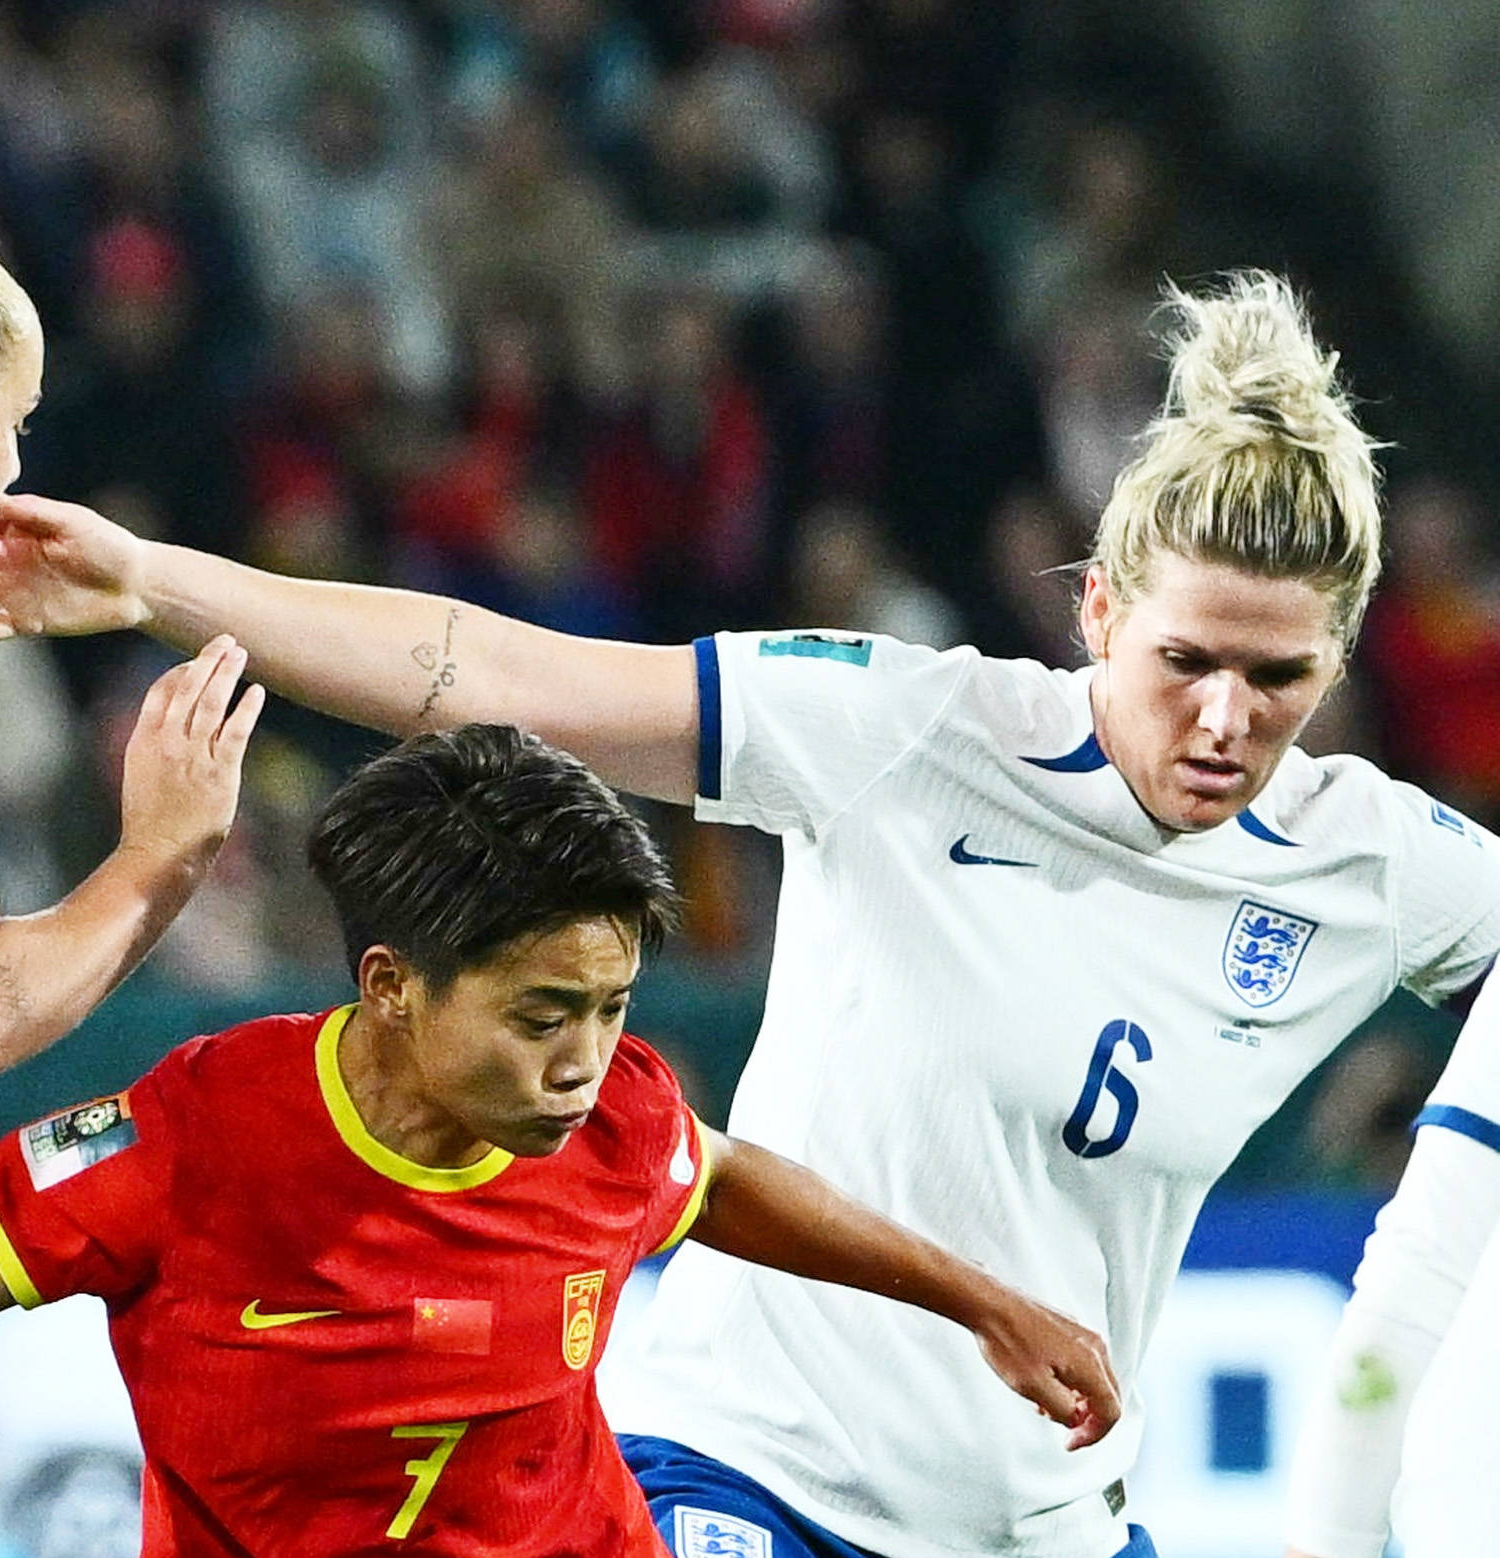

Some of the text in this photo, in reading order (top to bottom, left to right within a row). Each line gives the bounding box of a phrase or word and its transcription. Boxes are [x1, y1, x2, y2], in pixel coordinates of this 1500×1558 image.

[1061, 1018, 1153, 1159] 6
[568, 1276, 601, 1299] CFA
[385, 1422, 469, 1540] 7
